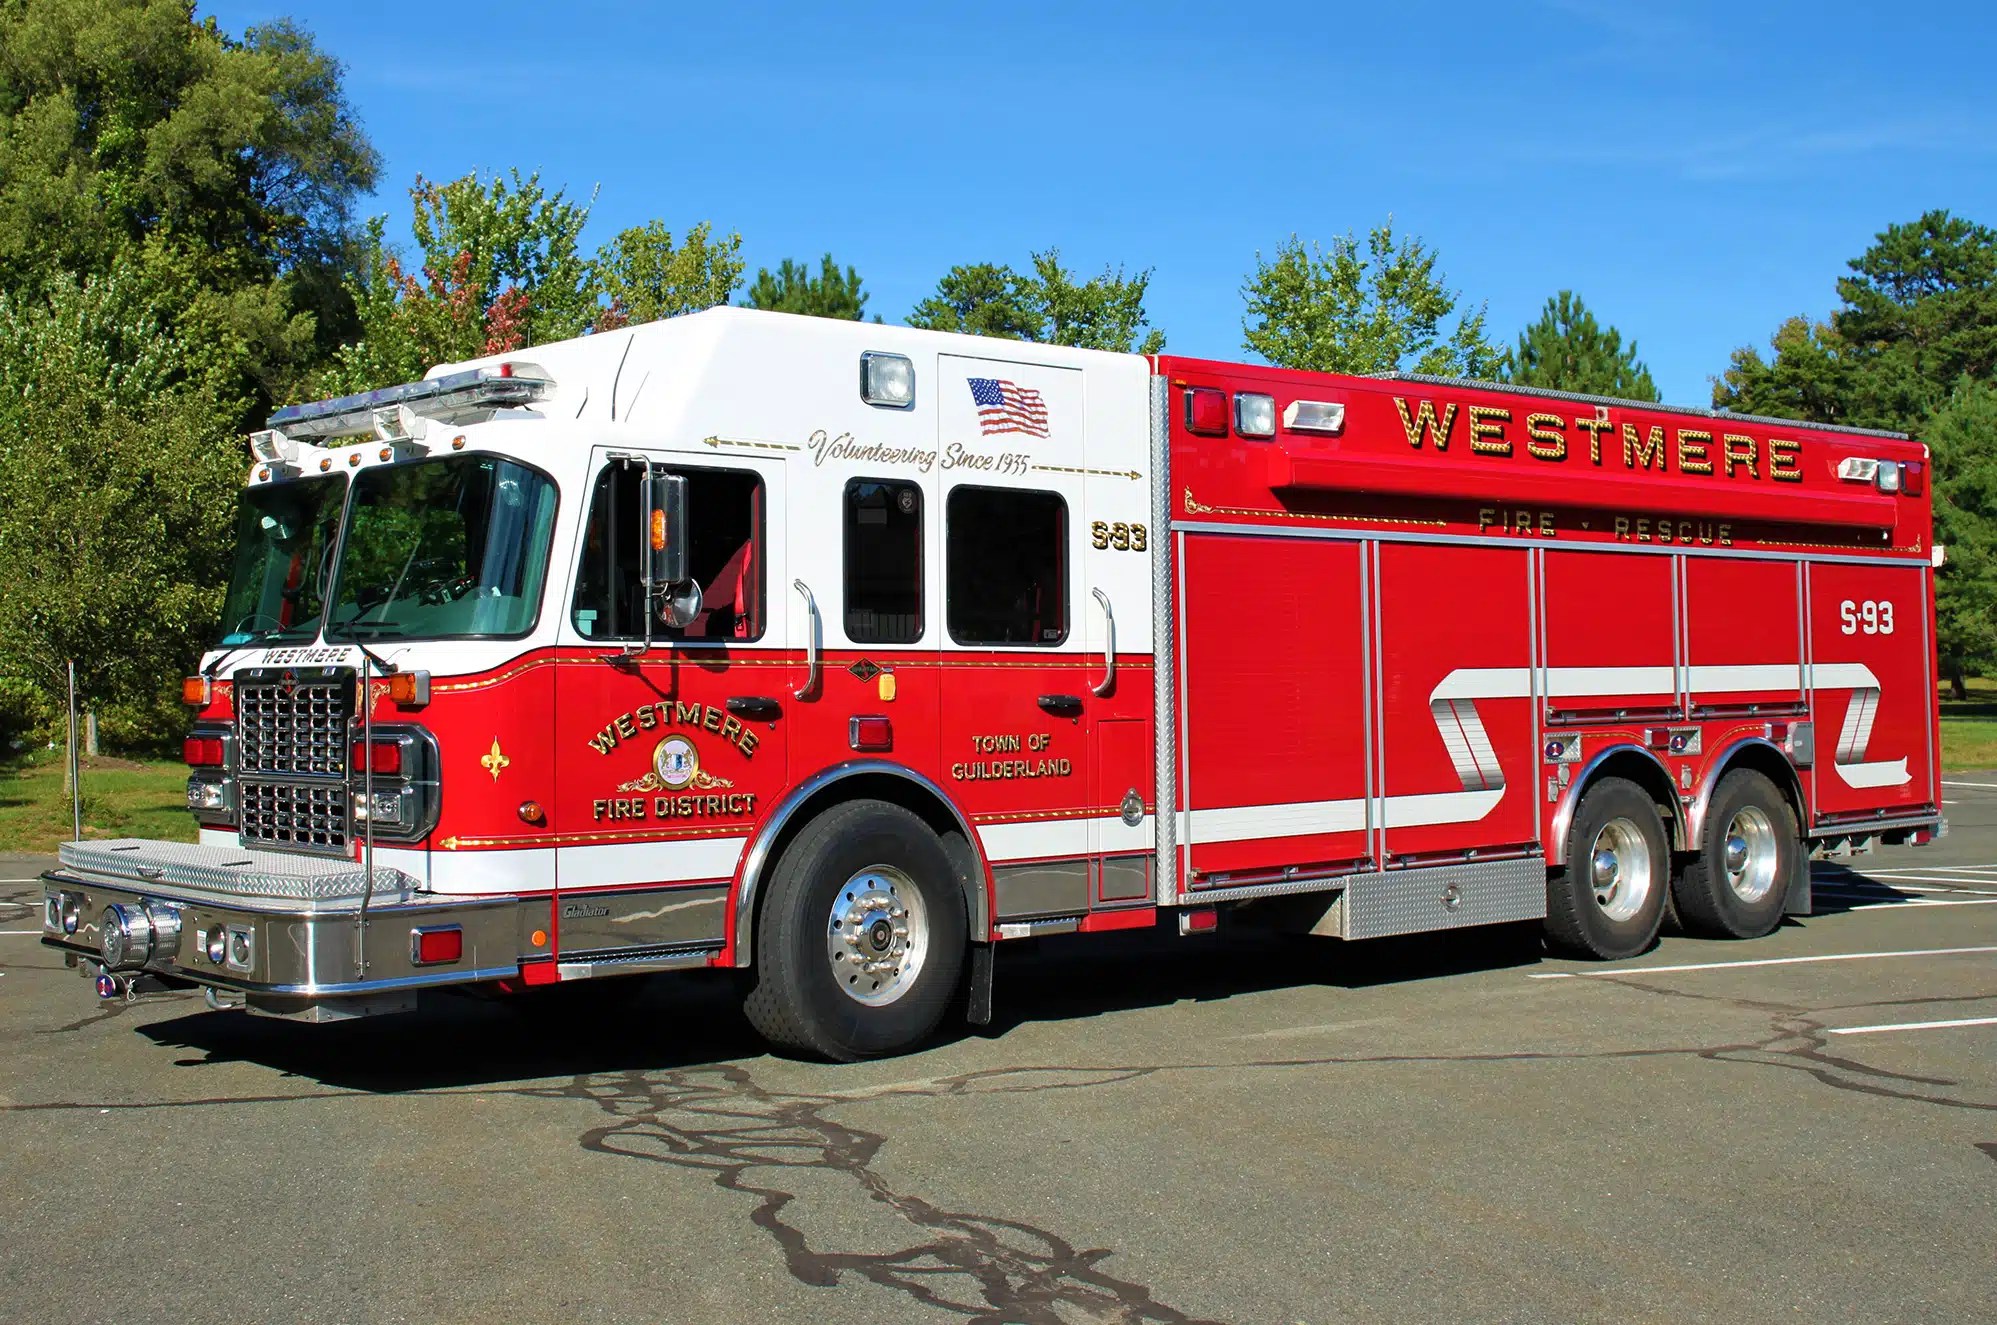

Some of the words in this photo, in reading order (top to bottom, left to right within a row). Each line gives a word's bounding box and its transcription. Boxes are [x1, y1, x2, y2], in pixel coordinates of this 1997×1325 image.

[807, 429, 937, 473] Volunteering
[940, 442, 994, 471] Since
[994, 453, 1031, 476] 1935
[1392, 396, 1802, 482] WESTMERE
[1479, 508, 1556, 536] FIRE
[1615, 516, 1733, 546] RESCUE
[261, 647, 352, 664] WESTMERE
[588, 700, 760, 757] WESTMERE
[972, 734, 1020, 753] TOWN
[1028, 733, 1051, 751] OF
[951, 758, 1072, 780] GUILDERLAND
[593, 797, 646, 820] FIRE
[654, 793, 758, 818] DISTRICT
[563, 903, 610, 919] Gladiator
